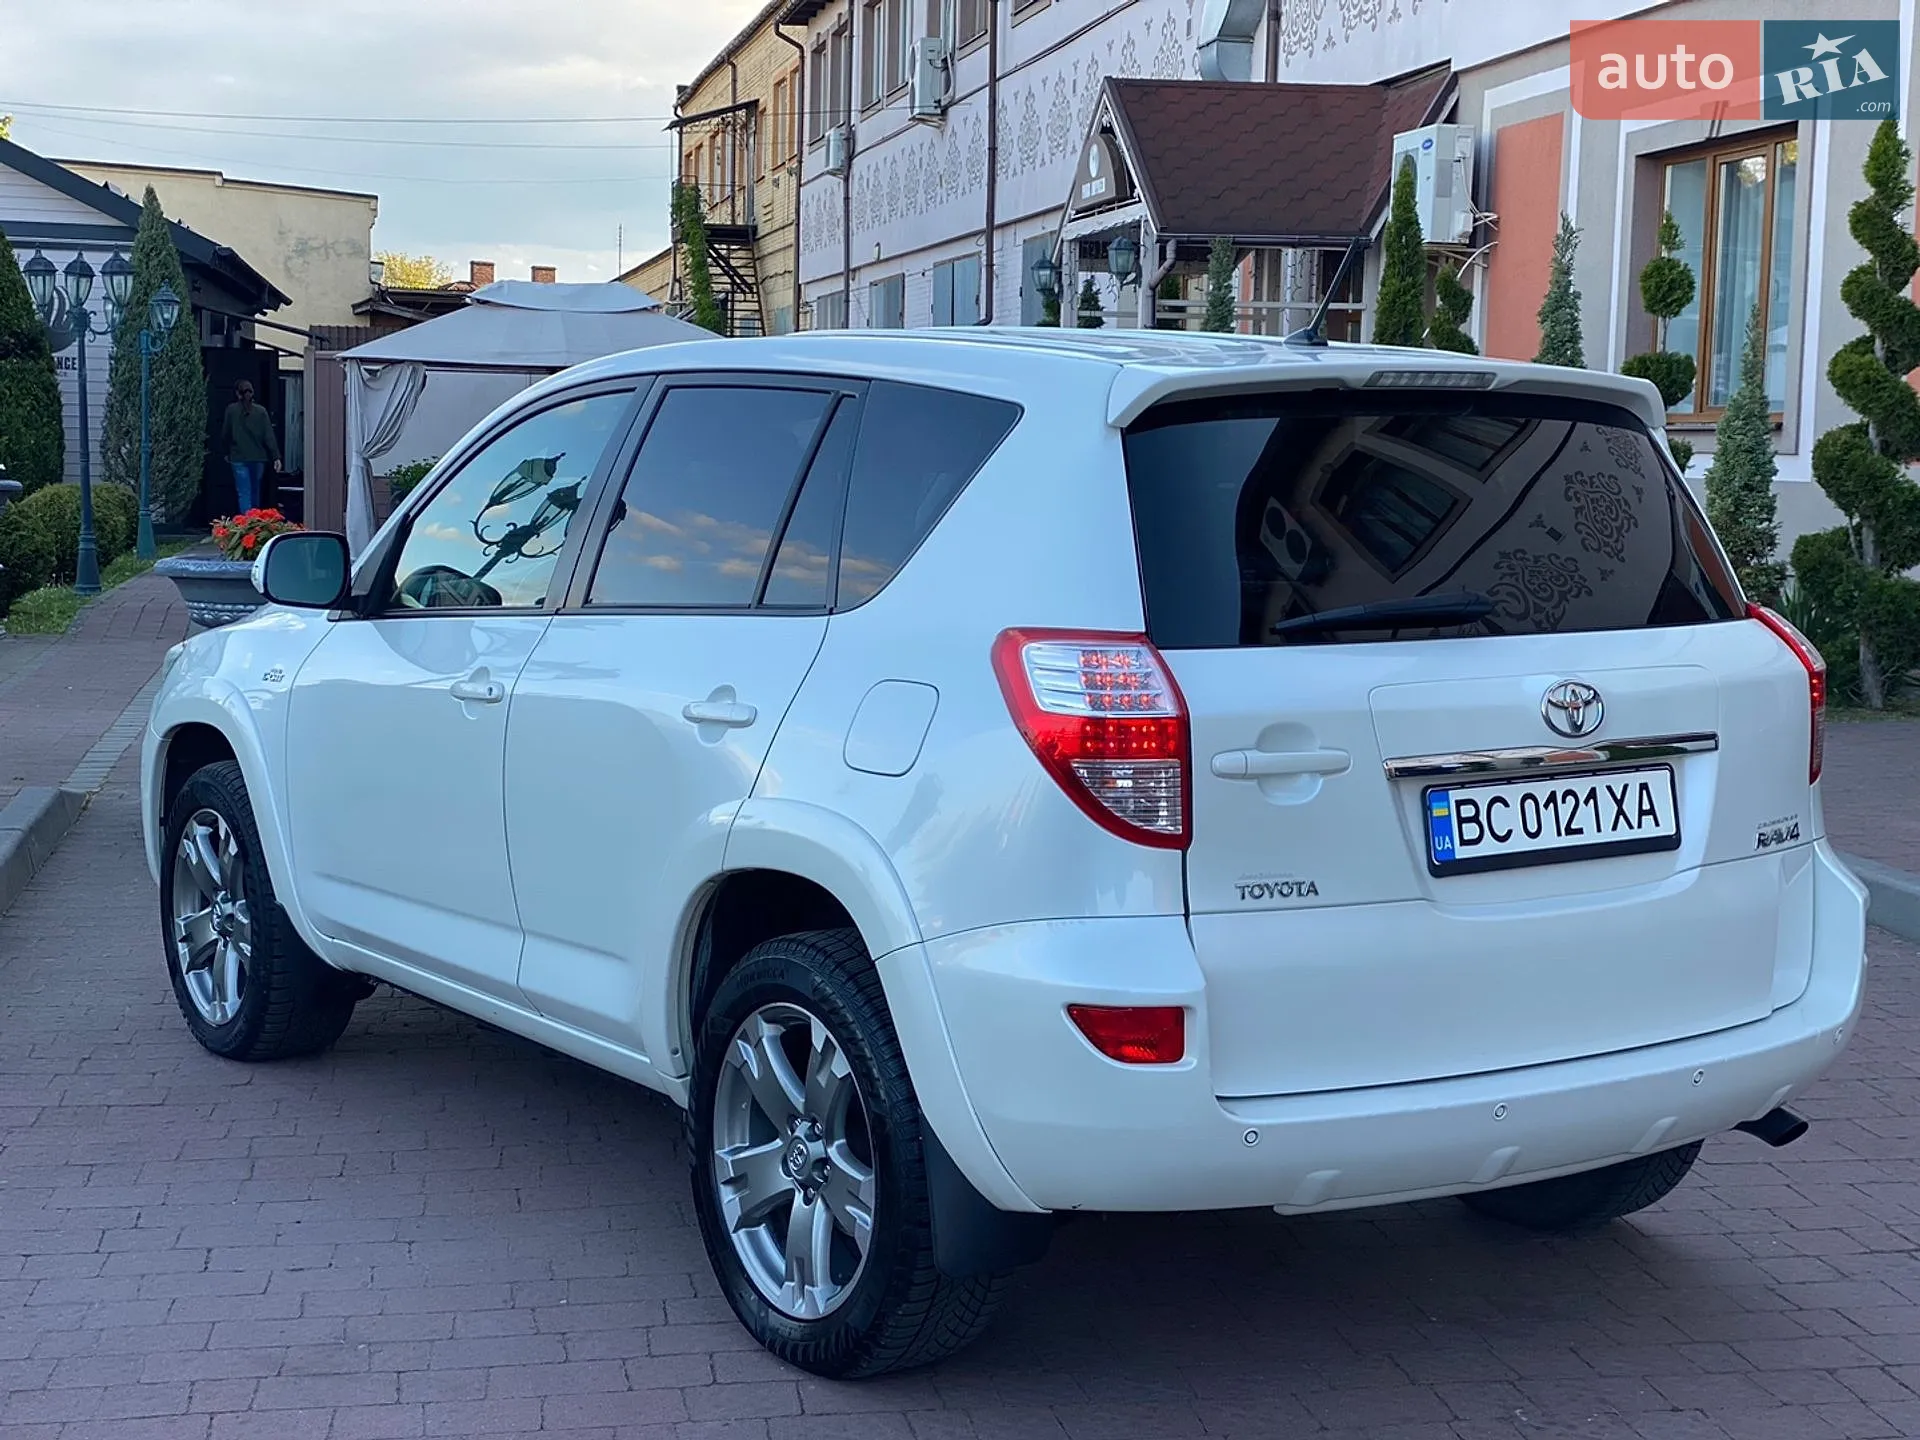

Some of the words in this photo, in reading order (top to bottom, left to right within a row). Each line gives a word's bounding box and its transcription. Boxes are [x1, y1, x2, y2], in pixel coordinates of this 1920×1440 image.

[1434, 835, 1453, 850] UA
[1755, 822, 1800, 850] RAV4
[1235, 881, 1319, 900] TOYOTA
